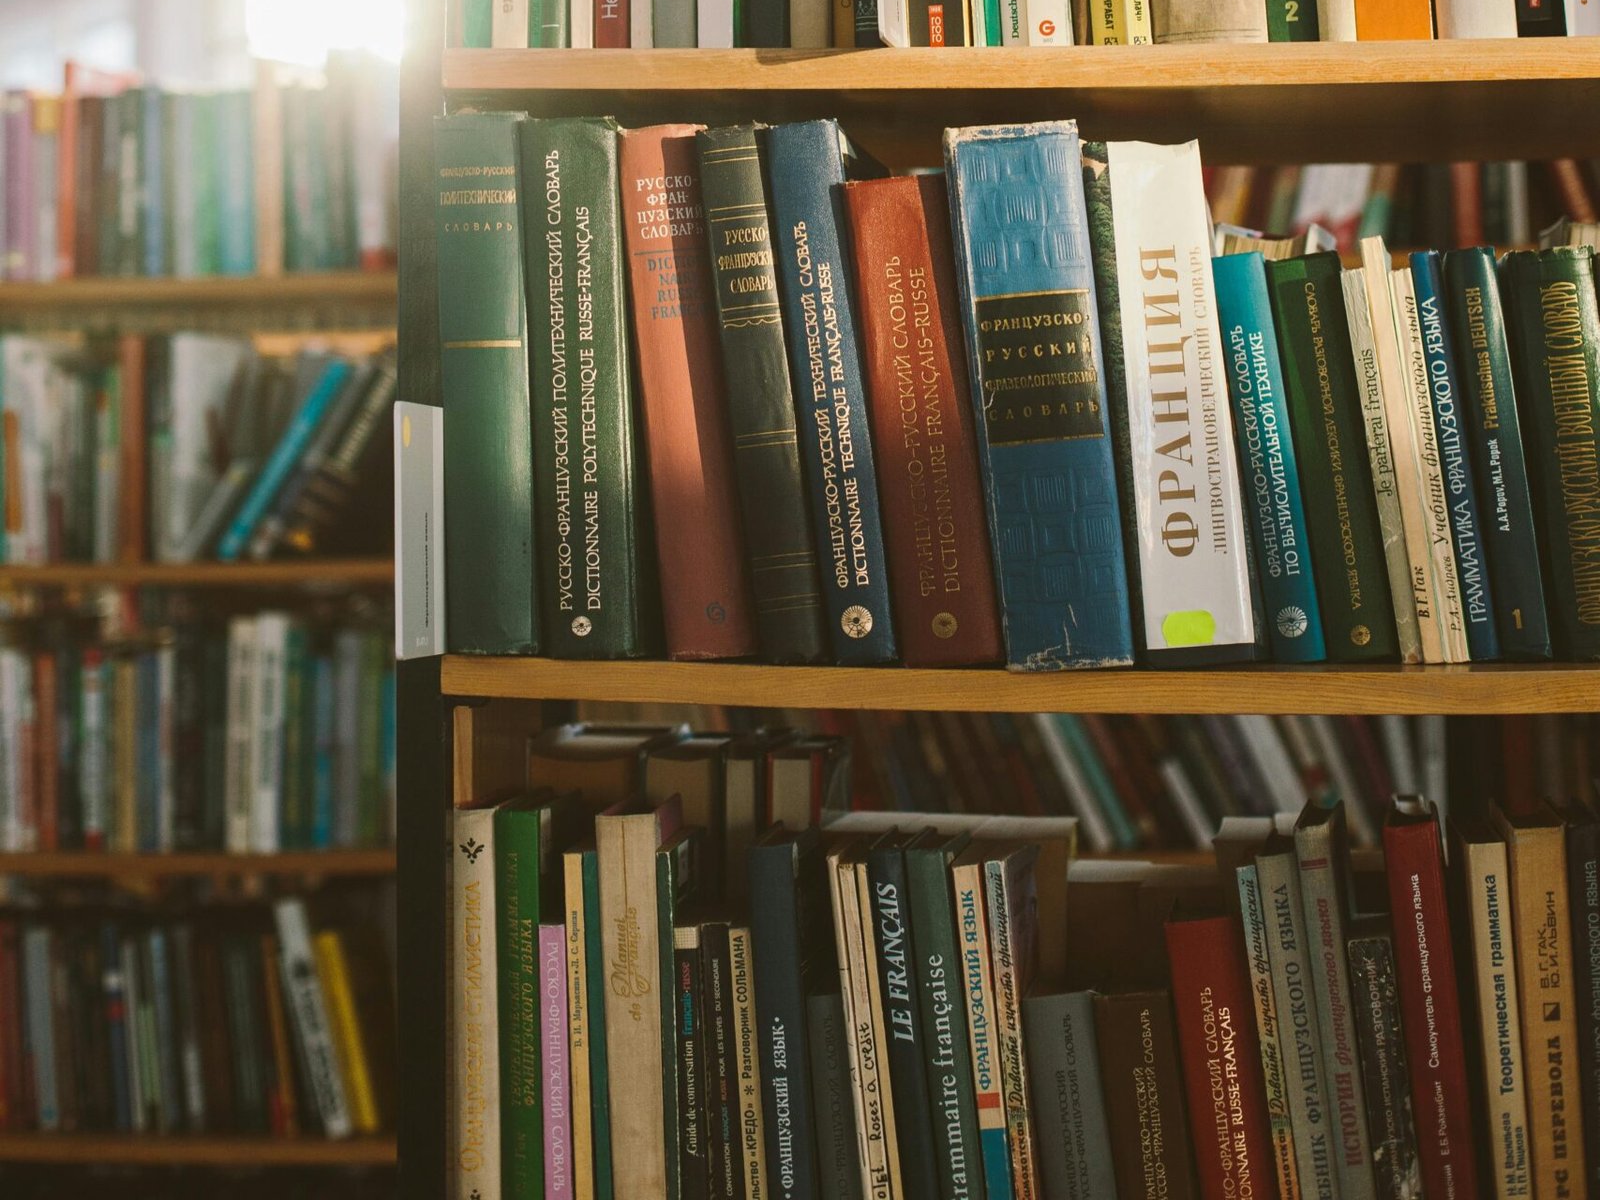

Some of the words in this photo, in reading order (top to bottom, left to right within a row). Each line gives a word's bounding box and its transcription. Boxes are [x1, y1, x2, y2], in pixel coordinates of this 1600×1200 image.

[1008, 8, 1020, 48] Deutsch
[1285, 0, 1299, 22] 2
[545, 150, 561, 225] СЛОВАРЬ
[636, 204, 704, 225] ЦУЗСКИЙ
[646, 191, 689, 206] ФРАН-
[445, 221, 513, 233] СЛОВАРЬ
[793, 221, 814, 287] СЛОВАРЬ
[575, 206, 594, 342] RUSSE-FRANÇAIS
[730, 274, 774, 294] СЛОВАРЬ
[885, 256, 909, 349] СЛОВАРЬ
[1189, 245, 1208, 320] СЛОВАРЬ
[1304, 281, 1323, 334] СЛОВАРЬ
[545, 230, 568, 402] ПОЛИТЕХНИЧЕСКИЙ
[801, 292, 828, 403] ТЕХНИЧЕСКИЙ
[817, 262, 845, 383] FRANÇAIS-RUSSE
[909, 267, 943, 437] FRANÇAIS-RUSSE
[986, 334, 1092, 362] РУССКИЙ
[1421, 296, 1446, 354] ЯЗЫКА
[1464, 286, 1489, 349] DEUTSCH
[1540, 281, 1584, 350] СЛОВАРЬ
[985, 365, 1098, 392] ФРАЗЕОЛОГИЧЕСКИЙ
[1229, 324, 1253, 394] СЛОВАРЬ
[1248, 331, 1273, 400] ТЕХНИКЕ
[1312, 336, 1335, 416] РАЗГОВОРНОЙ
[1358, 348, 1381, 411] français
[1475, 351, 1500, 430] Praktisches
[1543, 354, 1594, 438] ВОЕННЫЙ
[580, 349, 598, 484] POLYTECHNIQUE
[832, 387, 856, 473] TECHNIQUE
[988, 400, 1099, 421] СЛОВАРЬ
[1138, 245, 1200, 558] ФРАНЦИЯ
[1410, 350, 1439, 468] французского
[1430, 360, 1467, 496] ФРАНЦУЗСКОГО
[893, 355, 936, 598] ФРАНЦУЗСКО-РУССКИЙ
[1193, 326, 1227, 555] ЛИНГВОСТРАНОВЕДЧЕСКИЙ
[1258, 401, 1297, 547] ВЫЧИСЛИТЕЛЬНОЙ
[1324, 416, 1344, 472] ЛЕКСИКИ
[1366, 416, 1392, 475] parlerai
[552, 407, 573, 611] РУССКО-ФРАНЦУЗСКИЙ
[814, 408, 849, 589] ФРАНЦУЗСКО-РУССКИЙ
[929, 444, 961, 593] DICTIONNAIRE
[1239, 396, 1283, 578] ФРАНЦУЗСКО-РУССКИЙ
[1333, 474, 1357, 566] ФРАНЦУЗСКОГО
[1376, 480, 1393, 497] Je
[1427, 473, 1449, 546] Учебник
[584, 490, 601, 611] DICTIONNAIRE
[843, 476, 870, 587] DICTIONNAIRE
[1284, 550, 1301, 576] ПО
[1453, 499, 1488, 623] ГРАММАТИКА
[1347, 567, 1363, 611] ЯЗЫКА
[960, 889, 979, 943] ЯЗЫК
[990, 872, 1013, 968] французский
[1243, 878, 1270, 975] французский
[1272, 883, 1296, 952] ЯЗЫКА
[1409, 874, 1424, 910] языка
[1482, 874, 1506, 968] грамматика
[463, 880, 483, 1016] СТИЛИСТИКА
[519, 918, 533, 974] ЯЗЫКА
[732, 934, 750, 1003] СОЛЬМАНА
[875, 882, 911, 1002] FRANÇAIS
[1413, 912, 1434, 994] французского
[547, 941, 565, 1119] РУССКО-ФРАНЦУЗСКИЙ
[889, 1008, 915, 1044] LE
[925, 953, 956, 1068] française
[963, 949, 992, 1091] ФРАНЦУЗСКИЙ
[1001, 972, 1018, 1032] изучать
[1139, 1008, 1155, 1064] СЛОВАРЬ
[1199, 986, 1219, 1054] СЛОВАРЬ
[1257, 978, 1277, 1038] изучать
[1321, 951, 1354, 1067] французского
[1363, 957, 1387, 1046] РАЗГОВОРНИК
[1422, 995, 1441, 1069] Самоучитель
[1492, 974, 1516, 1095] Теоретическая
[521, 982, 535, 1107] ФРАНЦУЗСКОГО
[683, 1040, 697, 1106] conversation
[739, 1006, 755, 1080] Разговорник
[771, 1024, 788, 1069] ЯЗЫК
[1006, 1037, 1025, 1107] Давайте
[1061, 1013, 1077, 1066] СЛОВАРЬ
[1284, 962, 1322, 1125] ФРАНЦУЗСКОГО
[684, 1107, 697, 1120] de
[1264, 1043, 1286, 1113] Давайте
[1547, 1035, 1568, 1160] ПЕРЕВОДА
[684, 1121, 699, 1154] Guide
[744, 1102, 758, 1157] «КРЕДО»
[772, 1076, 795, 1190] ФРАНЦУЗСКИЙ
[1334, 1072, 1363, 1167] ИСТОРИЯ
[551, 1125, 566, 1192] СЛОВАРЬ
[722, 1142, 734, 1197] CONVERSATION
